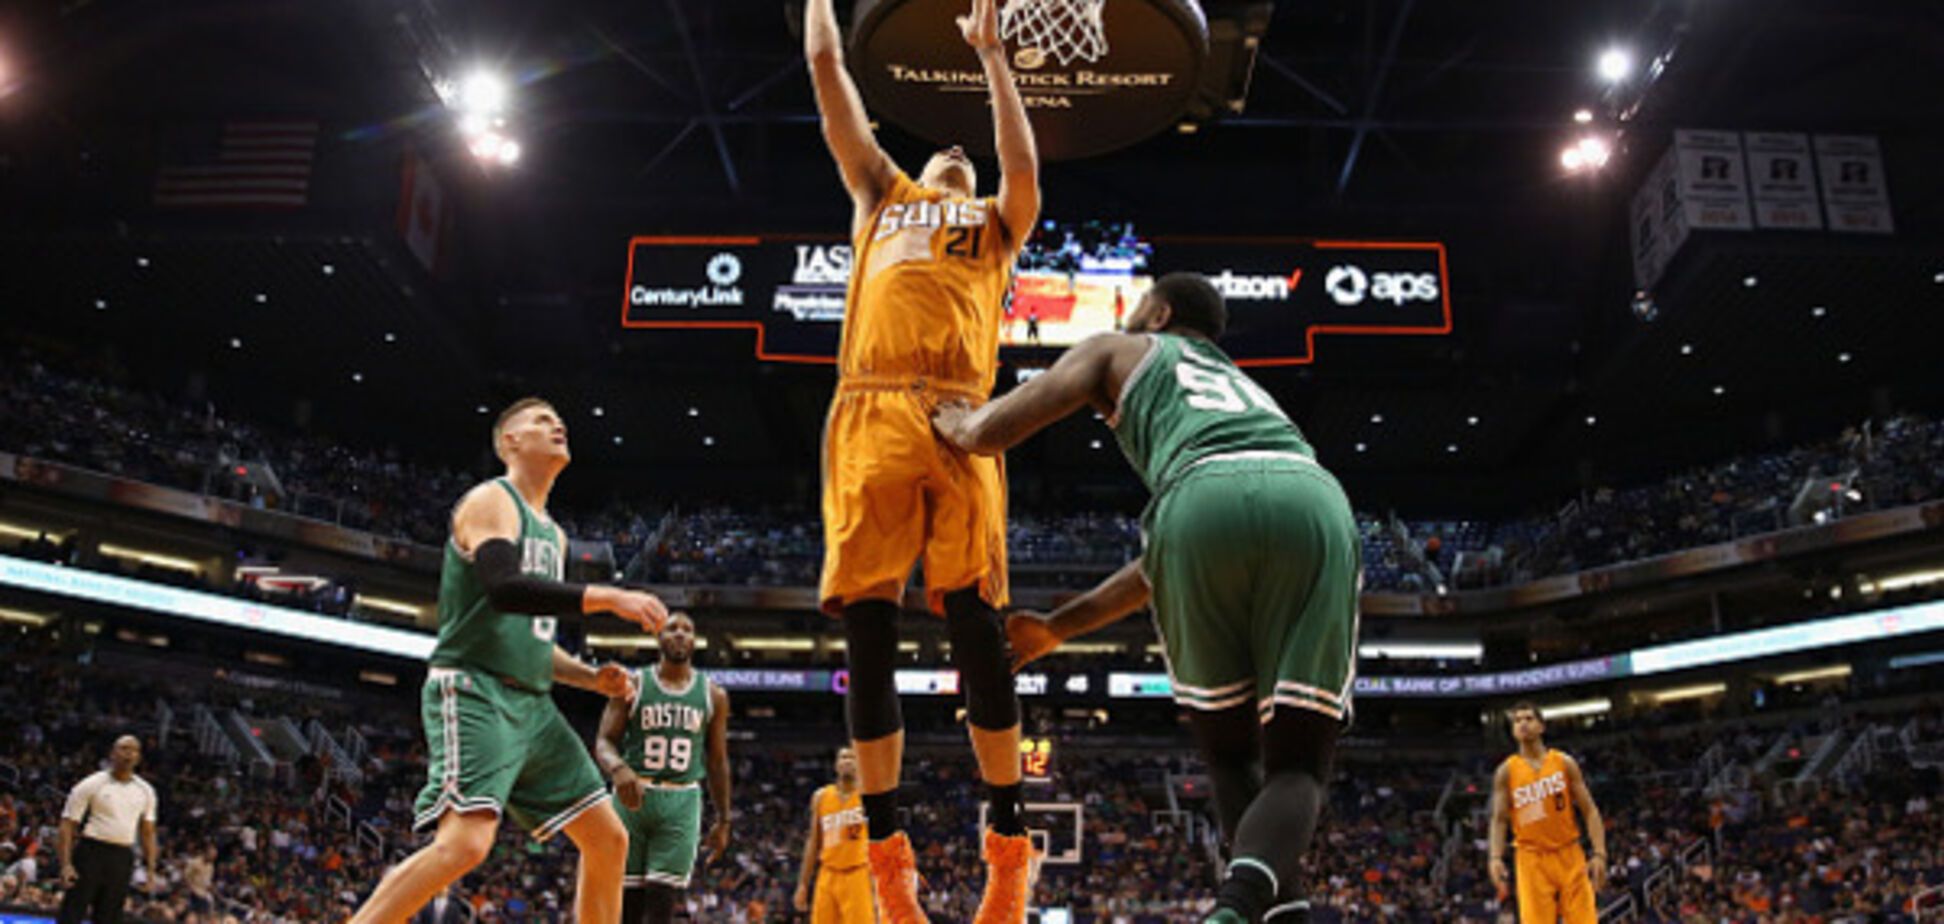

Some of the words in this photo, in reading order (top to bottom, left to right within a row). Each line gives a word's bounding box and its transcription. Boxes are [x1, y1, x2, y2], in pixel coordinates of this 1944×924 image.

[1075, 70, 1173, 86] RESORT
[874, 201, 988, 241] SUNS
[947, 227, 981, 258] 21
[795, 246, 854, 273] IAS
[631, 286, 744, 308] CenturyLink
[1371, 273, 1438, 305] aps
[1354, 677, 1390, 691] CIAL
[1393, 677, 1436, 691] BANK
[1439, 678, 1461, 691] OF
[1465, 676, 1495, 690] THE
[1500, 669, 1564, 688] PHOENIX
[641, 703, 703, 733] BOSTON
[644, 736, 691, 771] 99
[1513, 772, 1565, 808] SUNS
